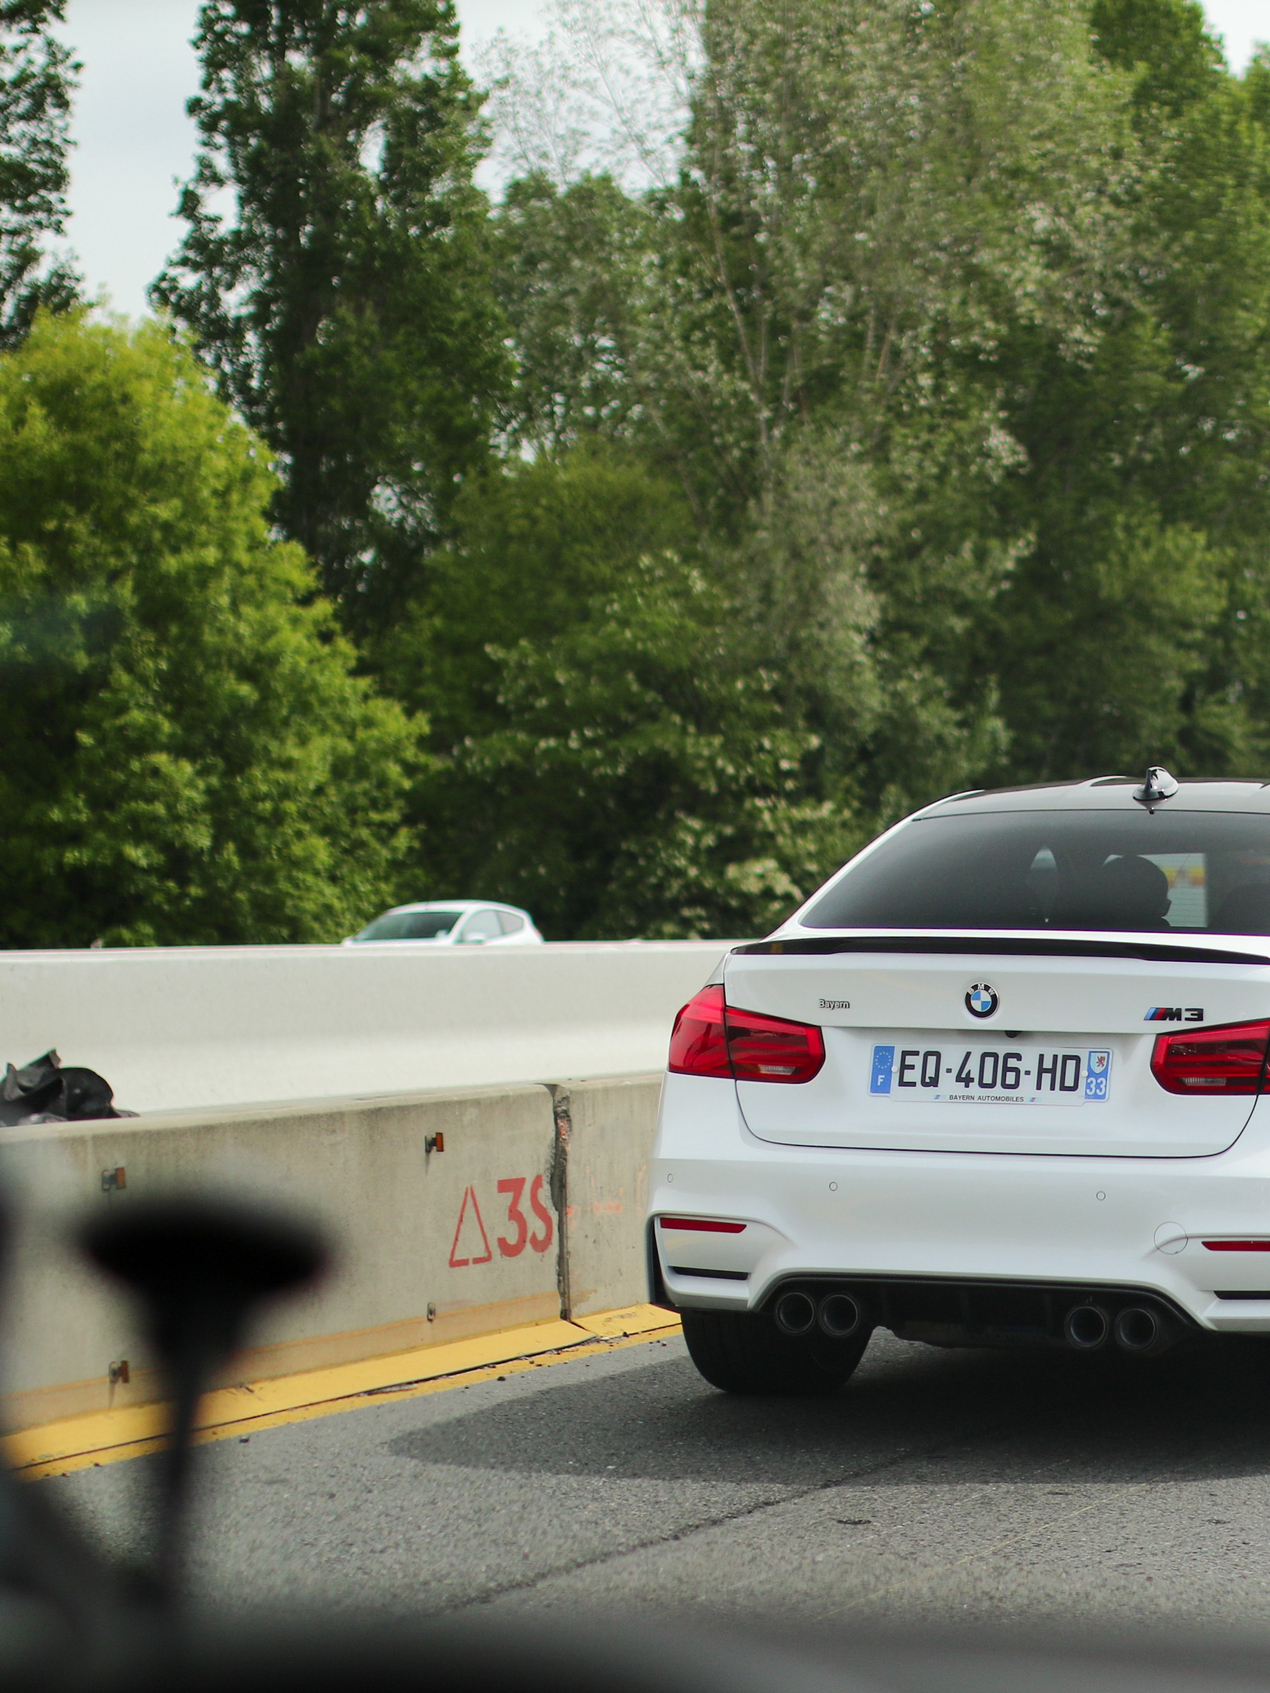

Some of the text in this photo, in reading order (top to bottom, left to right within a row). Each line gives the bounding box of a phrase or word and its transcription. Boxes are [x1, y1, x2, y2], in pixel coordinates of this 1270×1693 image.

[966, 983, 997, 996] BMW
[818, 998, 851, 1010] Bayern
[1144, 1007, 1204, 1021] M3
[898, 1050, 1082, 1091] EQ-406-HD
[876, 1074, 885, 1086] F
[1086, 1077, 1106, 1096] 33
